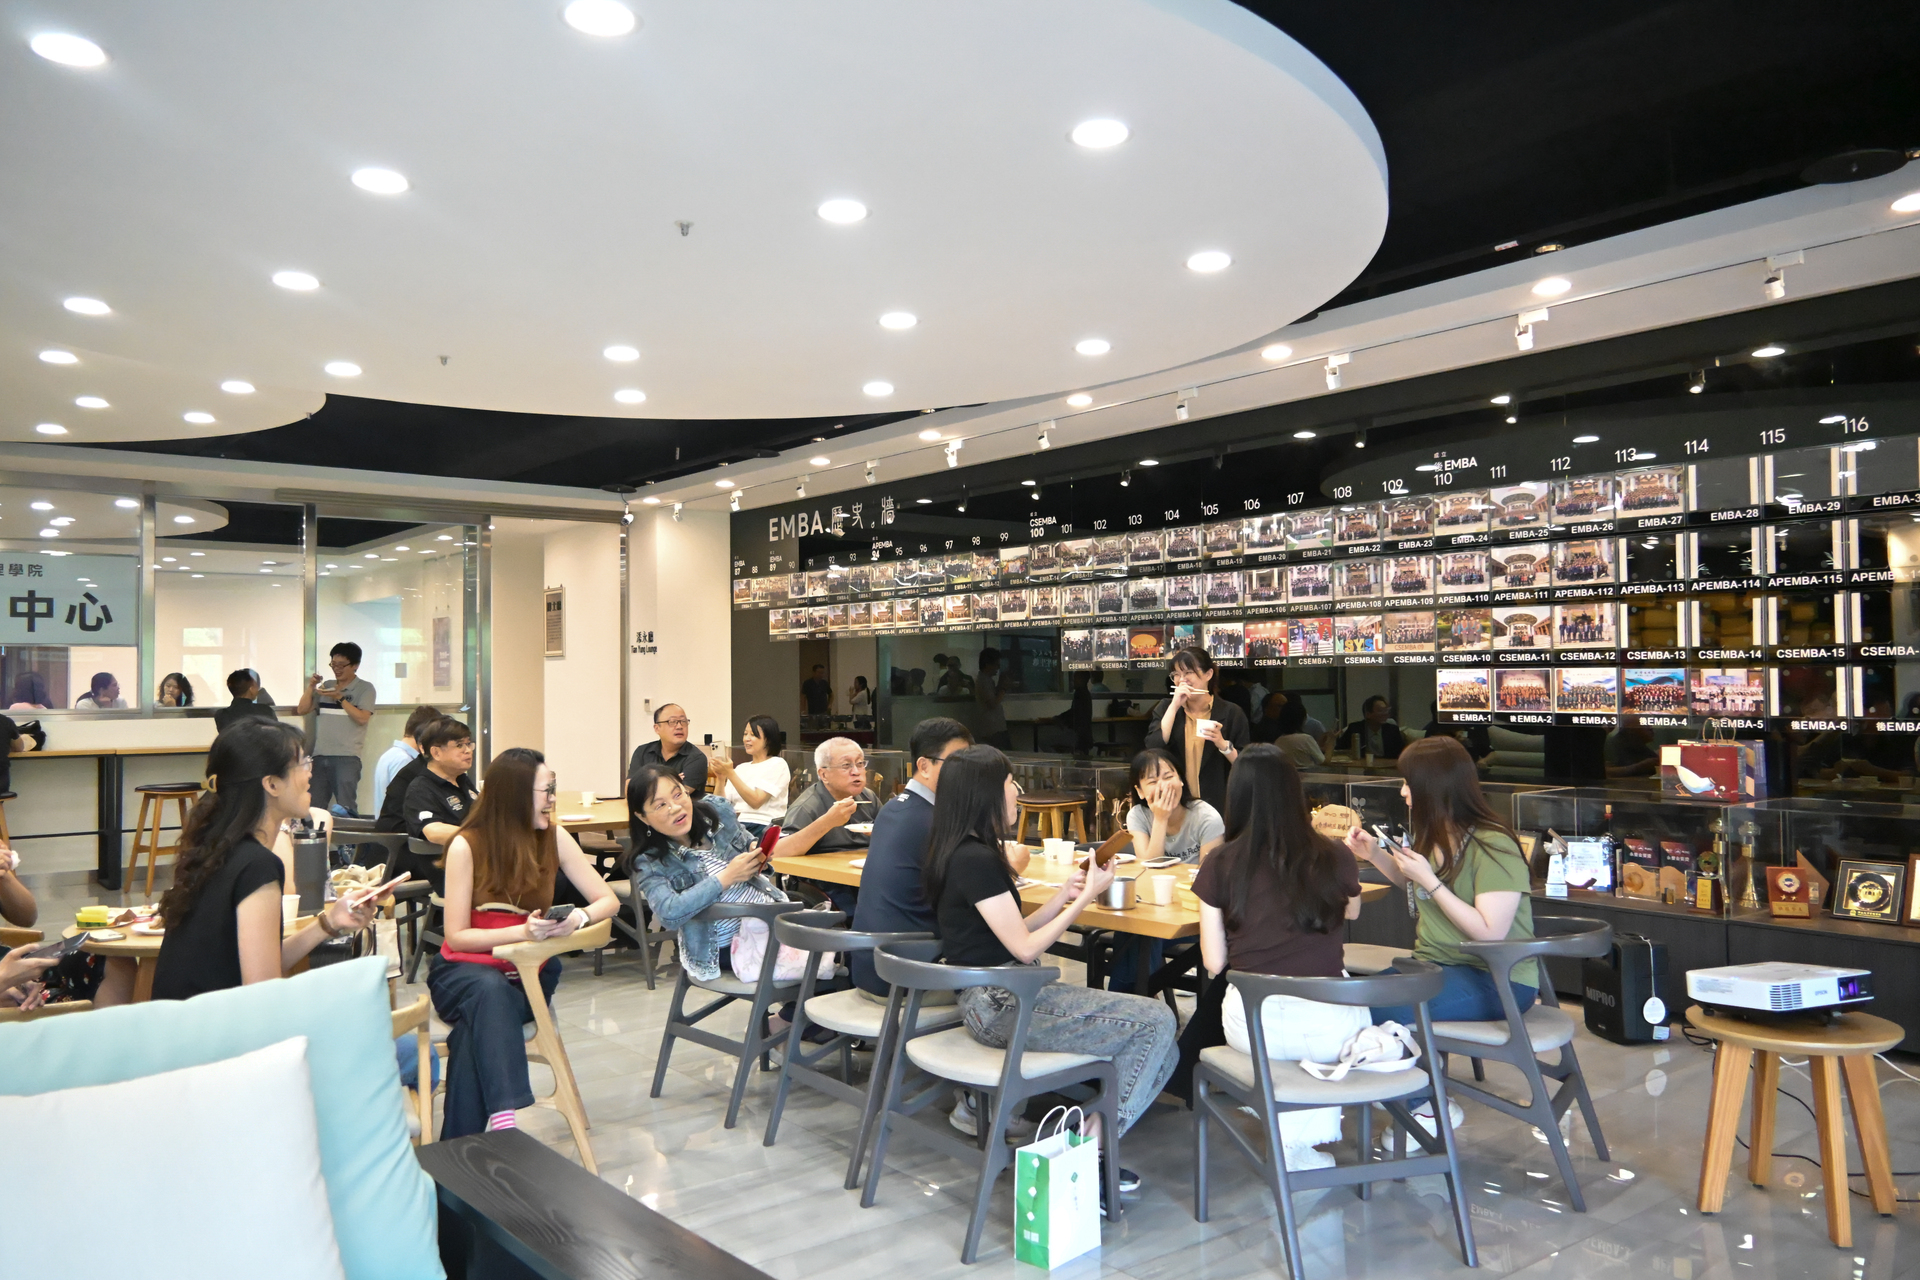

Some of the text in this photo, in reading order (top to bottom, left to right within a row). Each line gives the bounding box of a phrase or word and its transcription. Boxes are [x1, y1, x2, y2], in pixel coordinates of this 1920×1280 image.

[1841, 417, 1868, 434] 116
[1760, 428, 1786, 445] 115
[1684, 439, 1709, 455] 114
[1615, 448, 1637, 463] 113
[1550, 457, 1571, 471] 112
[1490, 465, 1508, 479] 111
[1433, 472, 1453, 486] 110
[1382, 479, 1403, 492] 109
[1333, 486, 1352, 498] 108
[1287, 492, 1304, 505] 107
[1244, 498, 1261, 510] 106
[1788, 501, 1841, 515] EMBA-29
[1164, 509, 1180, 521] 104
[1203, 504, 1219, 516] 105
[1710, 508, 1759, 521] EMBA-28
[1029, 516, 1057, 527] CSEMBA
[1093, 519, 1107, 530] 102
[1128, 514, 1143, 525] 103
[1638, 515, 1683, 528] EMBA-27
[769, 510, 824, 542] EMBA
[1061, 524, 1073, 534] 101
[1571, 522, 1614, 534] EMBA-26
[1000, 532, 1009, 542] 99
[1030, 527, 1045, 538] 100
[1509, 528, 1549, 540] EMBA-25
[945, 540, 953, 549] 97
[972, 536, 980, 545] 98
[1398, 539, 1433, 549] EMBA-23
[1451, 535, 1488, 545] EMBA-24
[895, 547, 903, 556] 95
[920, 544, 928, 553] 96
[1303, 549, 1332, 558] EMBA-21
[1348, 544, 1381, 554] EMBA-22
[850, 553, 857, 562] 93
[871, 550, 880, 559] 94
[1258, 554, 1287, 562] EMBA-20
[788, 561, 795, 569] 90
[808, 559, 814, 567] 91
[828, 556, 835, 564] 92
[1216, 558, 1243, 566] EMBA-19
[734, 568, 741, 576] 87
[752, 566, 758, 574] 88
[770, 563, 776, 572] 89
[1691, 578, 1761, 592] APEMBA-114
[1768, 573, 1843, 588] APEMBA-115
[1555, 587, 1614, 599] APEMBA-112
[1620, 582, 1685, 595] APEMBA-113
[1438, 594, 1489, 604] APEMBA-110
[1494, 590, 1549, 601] APEMBA-111
[1336, 600, 1381, 610] APEMBA-108
[1385, 597, 1433, 607] APEMBA-109
[10, 590, 113, 632] 中心
[1246, 606, 1287, 615] APEMBA-106
[1290, 603, 1332, 612] APEMBA-107
[1130, 613, 1164, 621] APEMBA-103
[1166, 611, 1202, 619] APEMBA-104
[1205, 609, 1243, 617] APEMBA-105
[1096, 615, 1128, 623] APEMBA-102
[1335, 634, 1383, 653] NSYSU
[1443, 654, 1491, 663] CSEMBA-10
[1499, 652, 1551, 662] CSEMBA-11
[1560, 651, 1616, 661] CSEMBA-12
[1626, 651, 1686, 661] CSEMBA-13
[1698, 649, 1762, 660] CSEMBA-14
[1776, 648, 1845, 659] CSEMBA-15
[1254, 659, 1287, 667] CSEMBA-6
[1298, 658, 1333, 666] CSEMBA-7
[1344, 656, 1383, 664] CSEMBA-8
[1393, 655, 1435, 664] CSEMBA-9
[1136, 661, 1164, 669] CSEMBA-3
[1639, 717, 1687, 727] 後EMBA-4
[1790, 720, 1847, 731] 後EMBA-6
[1586, 986, 1616, 1008] MIPRO
